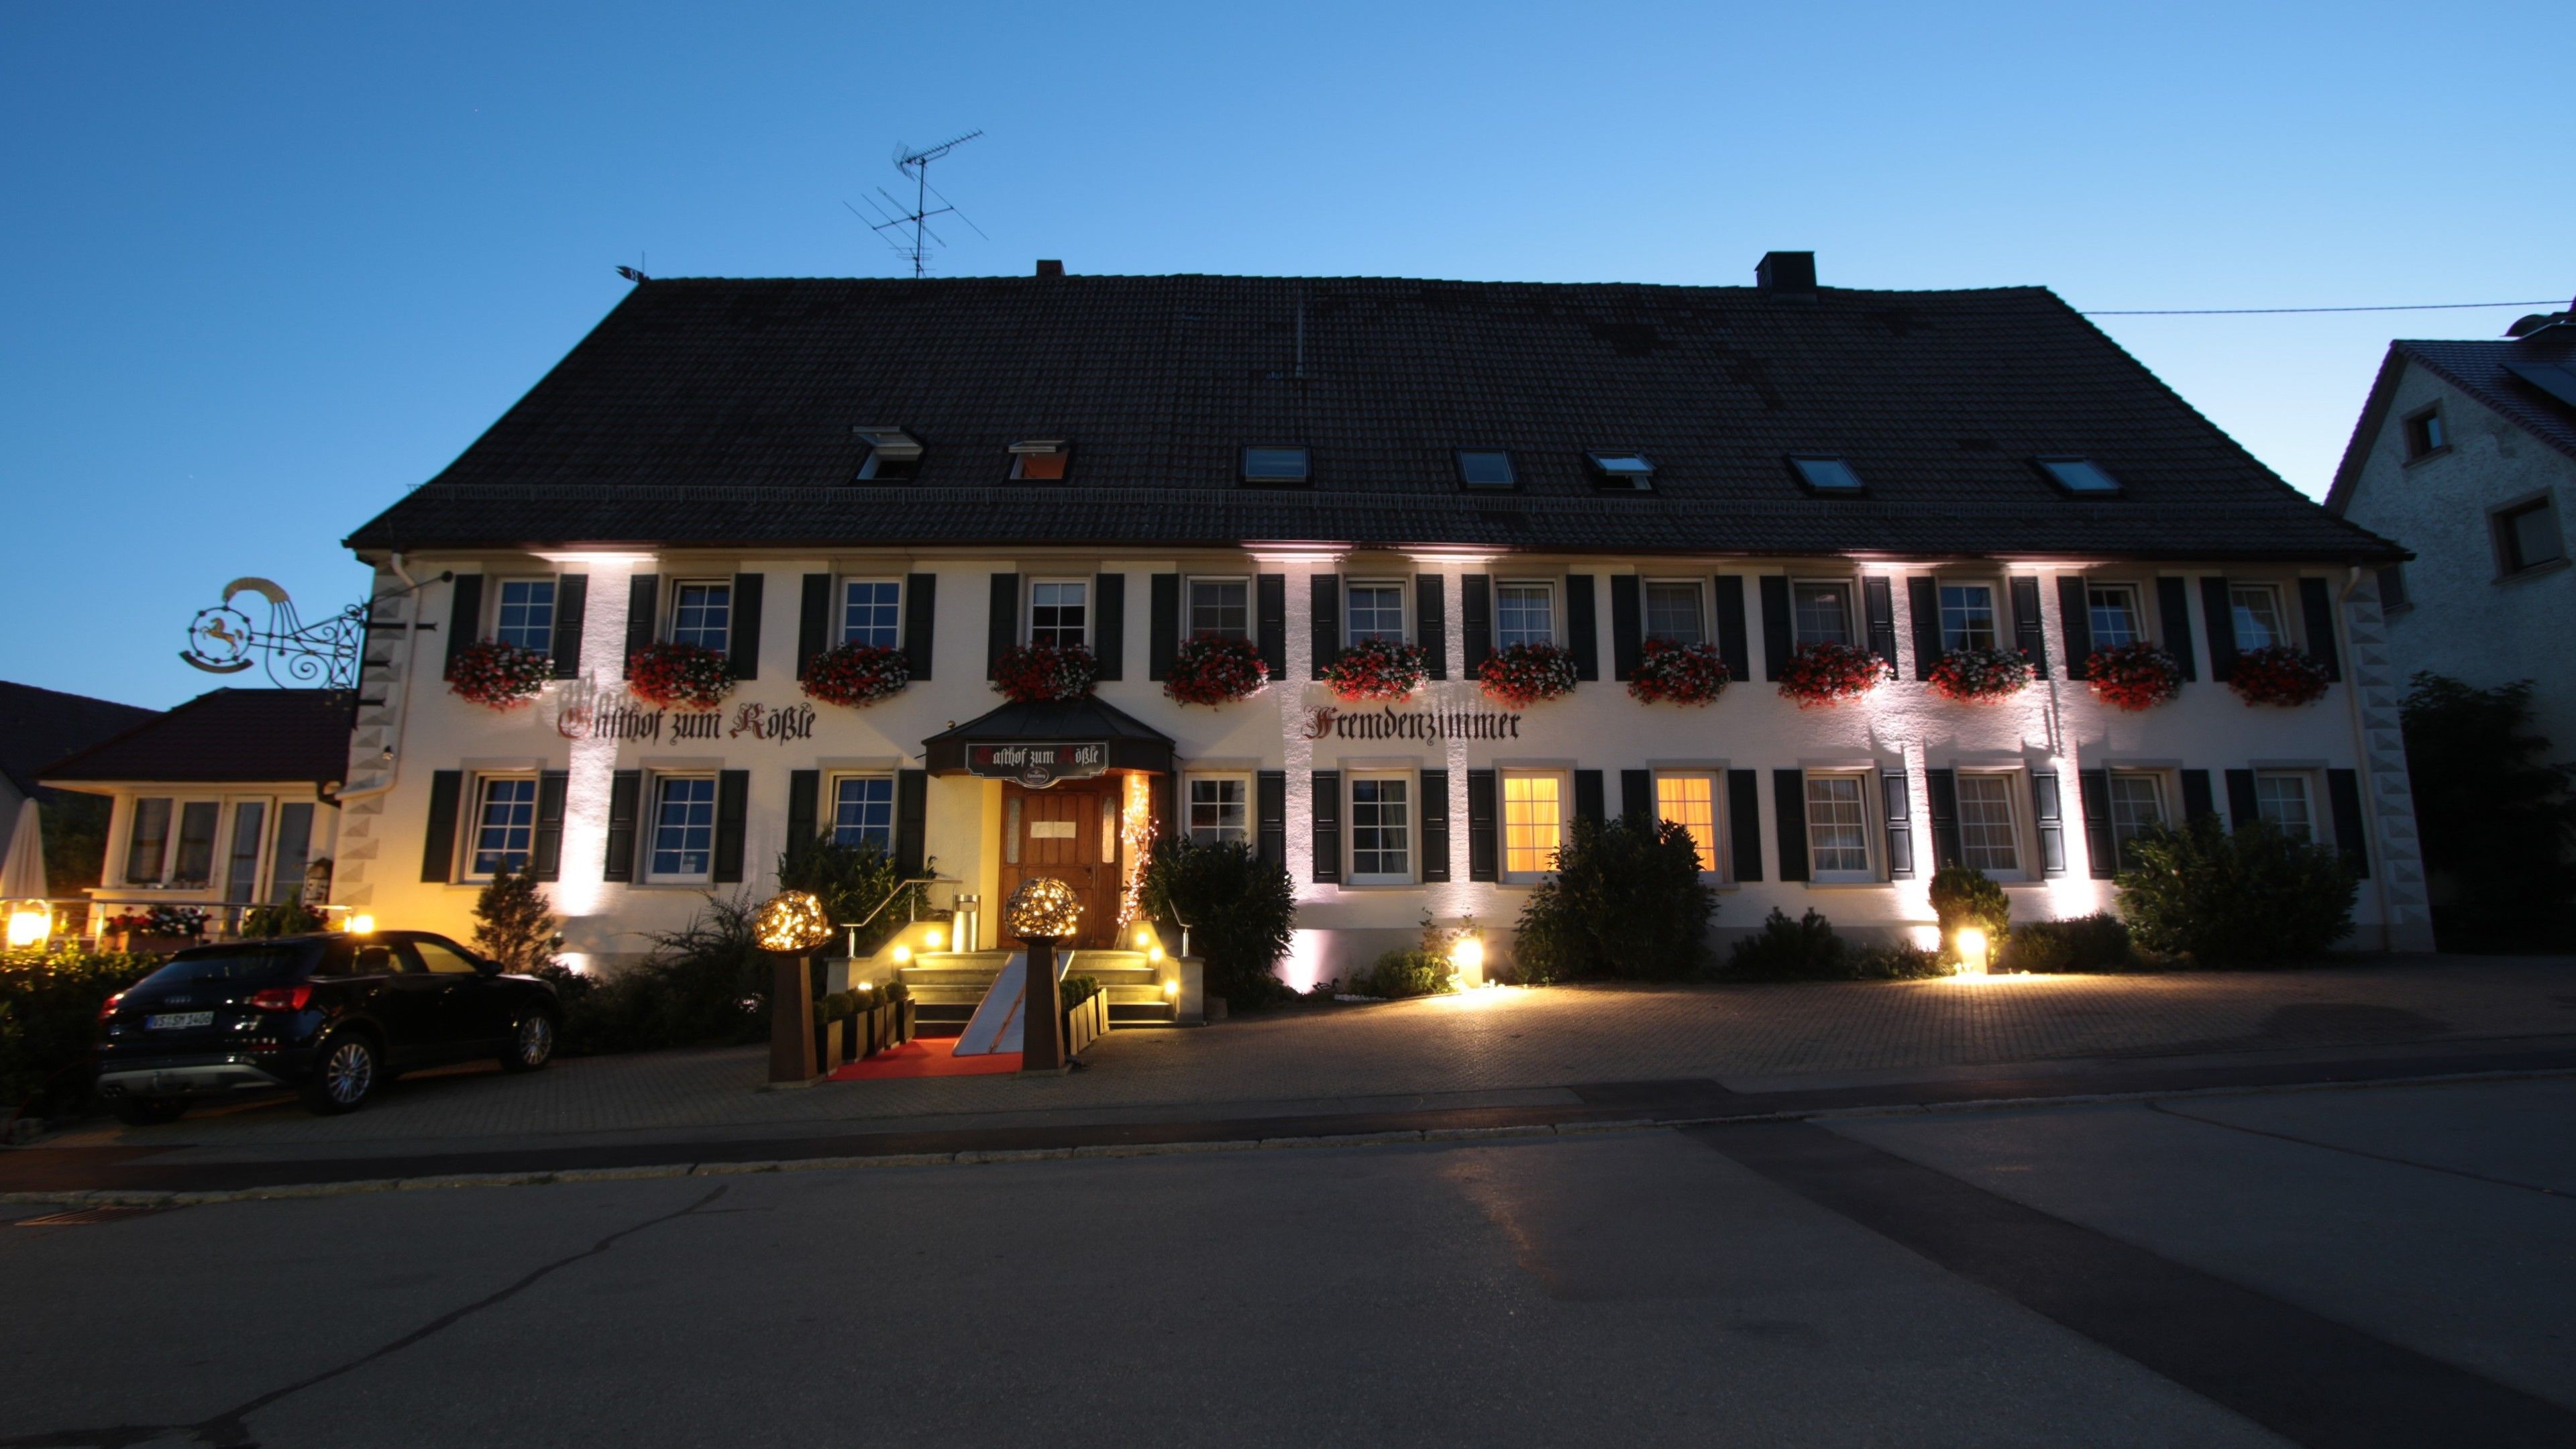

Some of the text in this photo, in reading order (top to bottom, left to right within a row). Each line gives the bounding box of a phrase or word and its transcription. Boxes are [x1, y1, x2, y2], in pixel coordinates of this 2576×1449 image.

[670, 710, 721, 745] zum
[1301, 704, 1521, 746] Fremdenzimmer
[1030, 750, 1055, 767] zum
